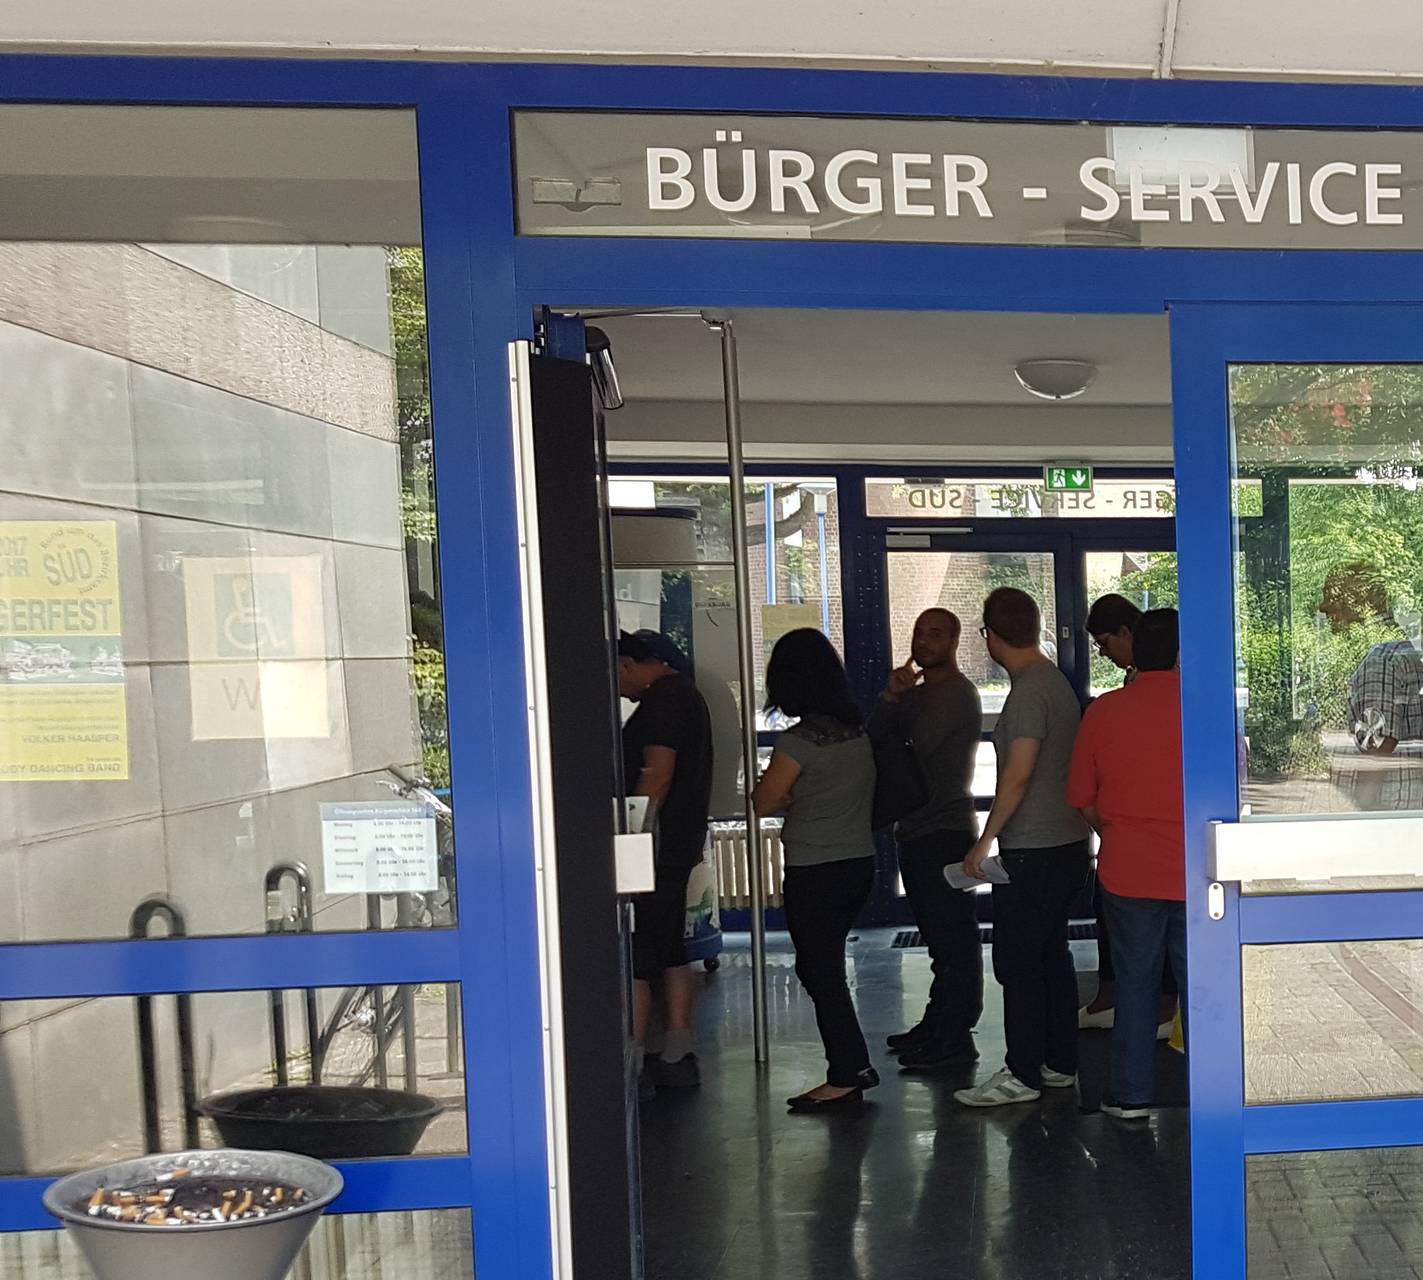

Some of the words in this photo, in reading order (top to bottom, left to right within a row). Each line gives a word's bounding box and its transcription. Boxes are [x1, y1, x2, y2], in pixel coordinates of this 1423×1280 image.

[646, 130, 994, 218] BÜRGER
[1079, 157, 1404, 225] SERVICE
[43, 543, 93, 587] SÜD
